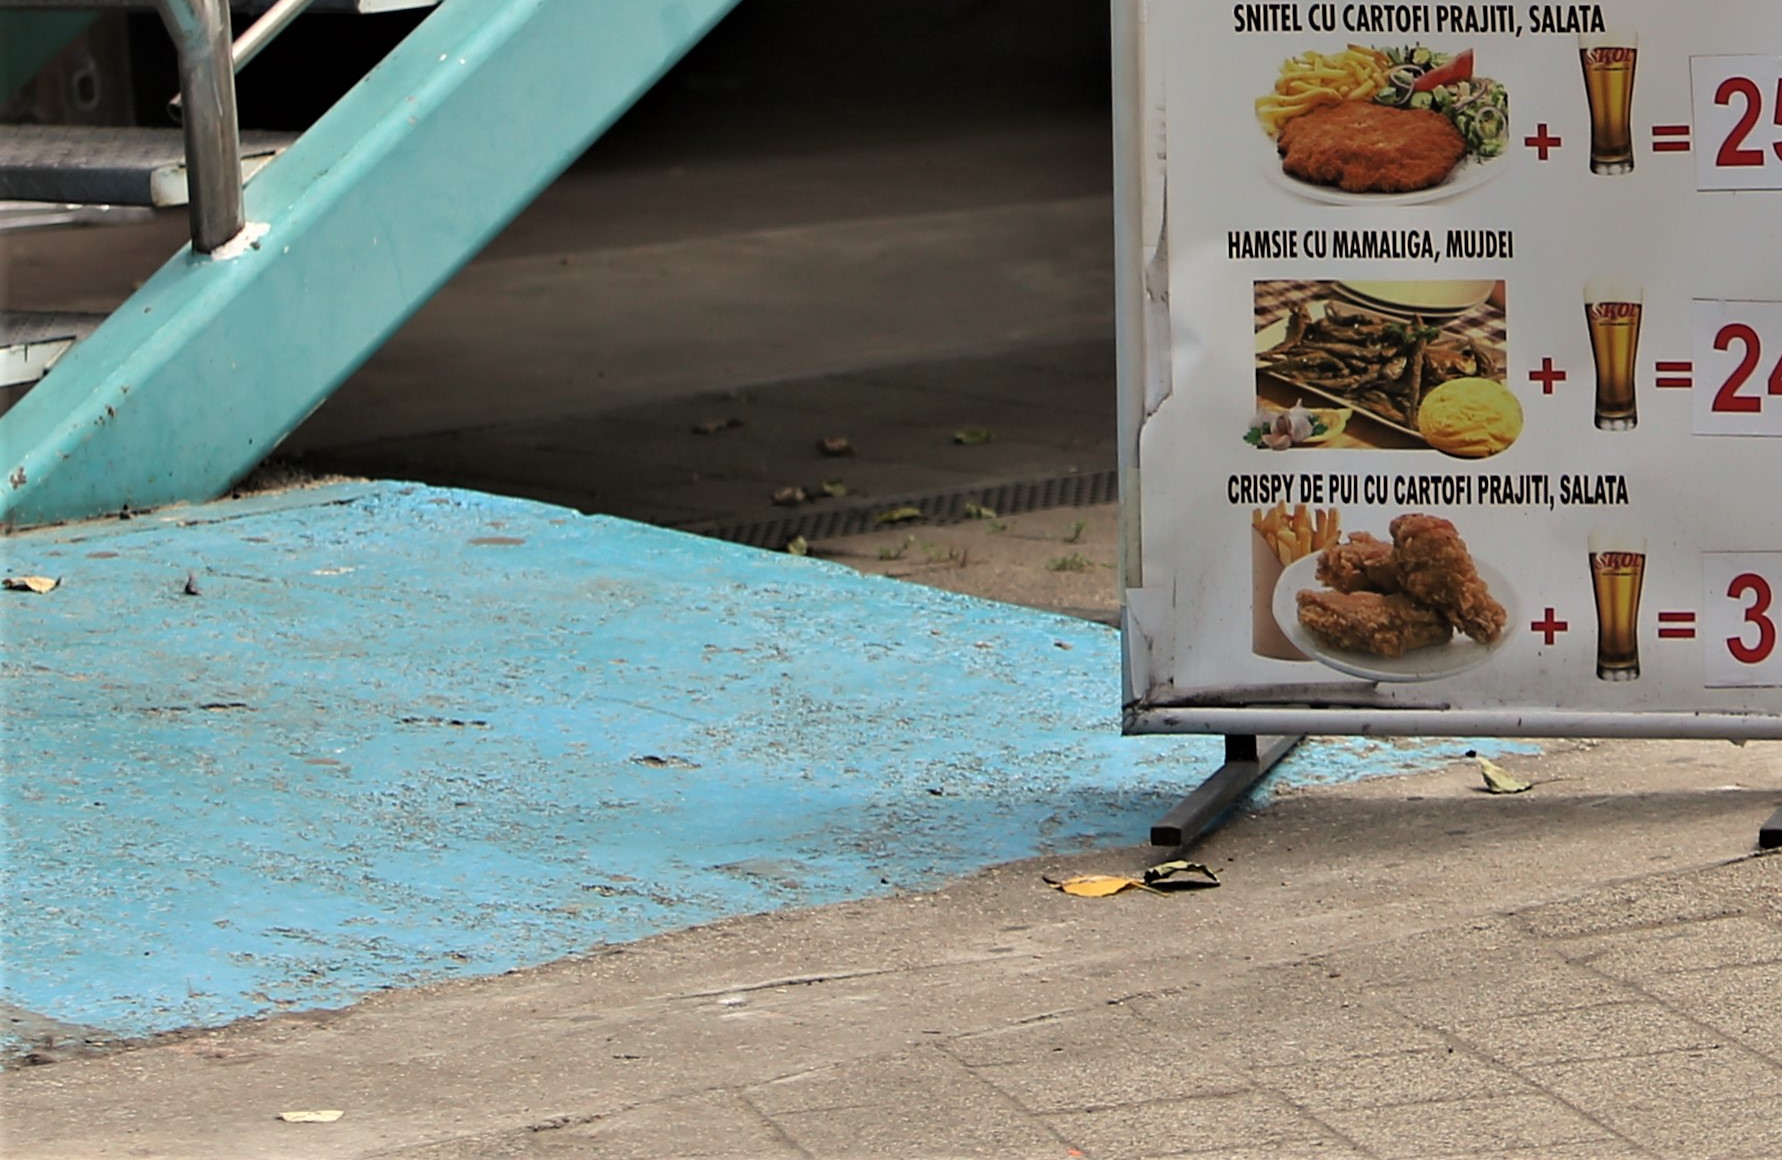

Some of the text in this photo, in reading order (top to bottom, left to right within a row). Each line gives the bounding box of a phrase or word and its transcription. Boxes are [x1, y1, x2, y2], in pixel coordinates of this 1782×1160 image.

[1234, 4, 1605, 37] SNITEL CU CARTOFI PRAJITI, SALATA
[1229, 231, 1512, 262] HAMSIE CU MAMALIGA, MUJDEI
[1228, 475, 1628, 509] CRISPY DE PUI CU CARTOFI PRAJITI, SALATA
